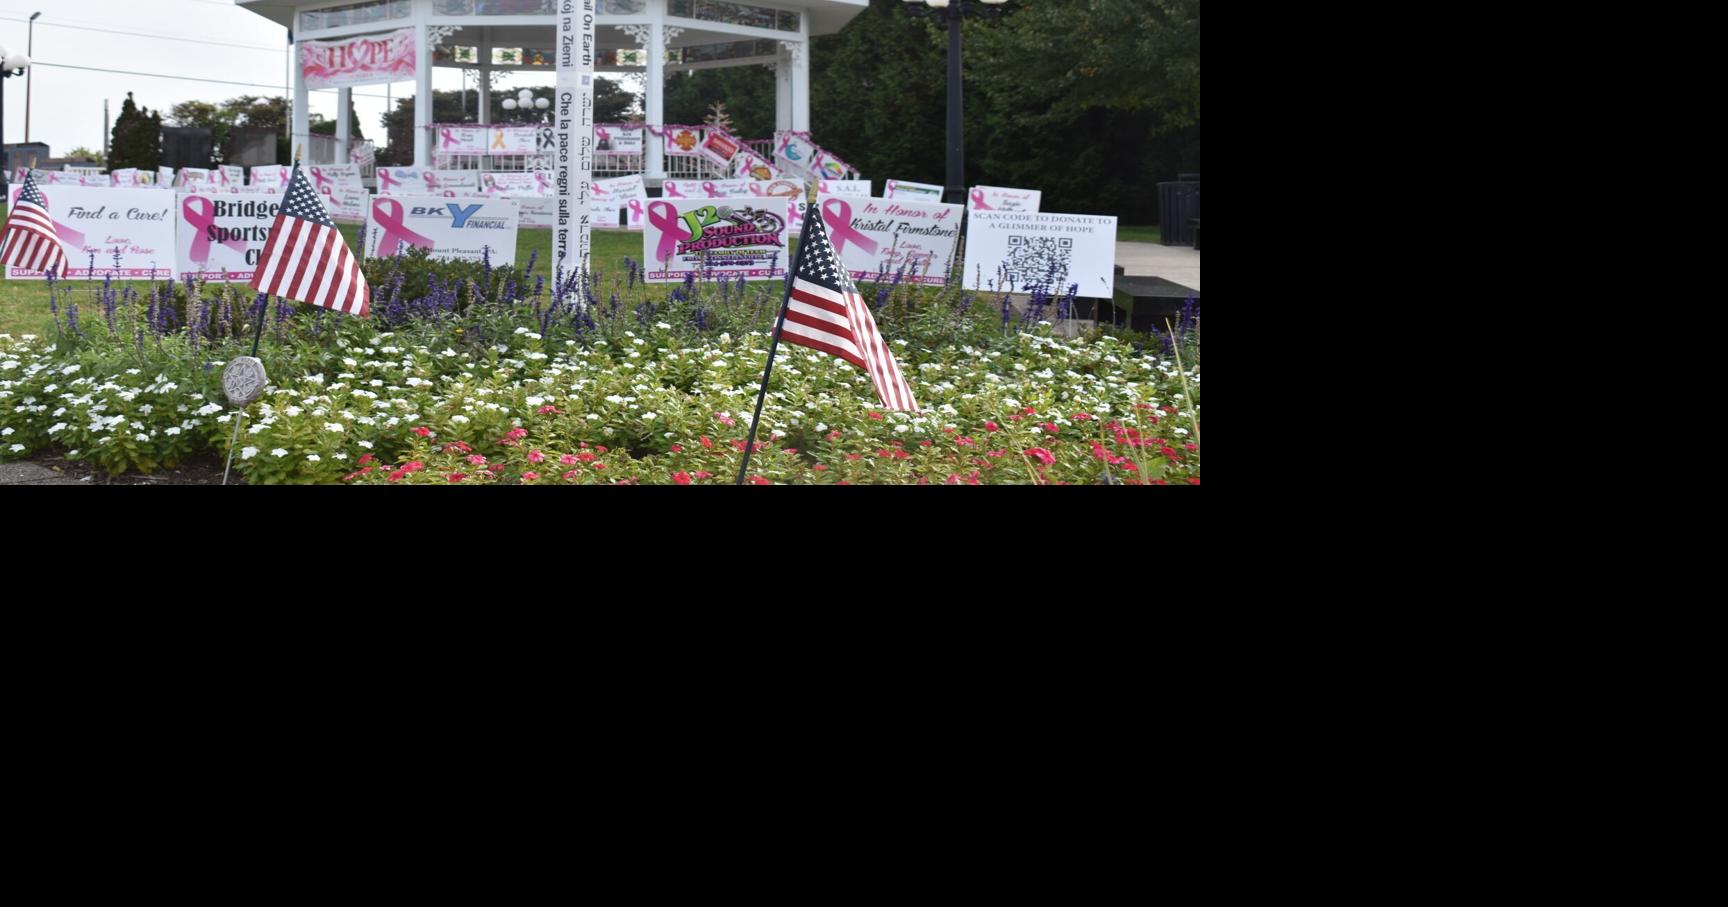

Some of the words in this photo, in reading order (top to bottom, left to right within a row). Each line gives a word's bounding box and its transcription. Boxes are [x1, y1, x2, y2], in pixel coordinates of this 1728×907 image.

[562, 17, 572, 32] na
[583, 14, 593, 30] On
[562, 34, 574, 67] Ziemi
[582, 33, 593, 66] Earth
[560, 92, 573, 116] Che
[560, 119, 572, 130] la
[557, 133, 569, 162] pace
[578, 136, 591, 171] שלום
[556, 165, 570, 195] regni
[577, 181, 589, 206] עלי
[67, 205, 106, 220] Find
[108, 211, 120, 220] a
[126, 207, 168, 221] Cure!
[558, 199, 570, 226] sulla
[863, 203, 878, 214] In
[884, 204, 928, 218] Honor
[932, 208, 951, 222] of
[974, 212, 1001, 220] SCAN
[1002, 214, 1032, 222] CODE
[1034, 214, 1049, 222] TO
[1051, 216, 1095, 224] DONATE
[1096, 217, 1112, 225] TO
[466, 219, 505, 230] FINANCIAL
[703, 222, 756, 238] SOUND
[849, 217, 894, 233] Kristal
[896, 221, 957, 238] Firmstone
[998, 223, 1048, 231] GLIMMER
[557, 228, 569, 258] terra
[676, 232, 785, 255] PRODUCTION
